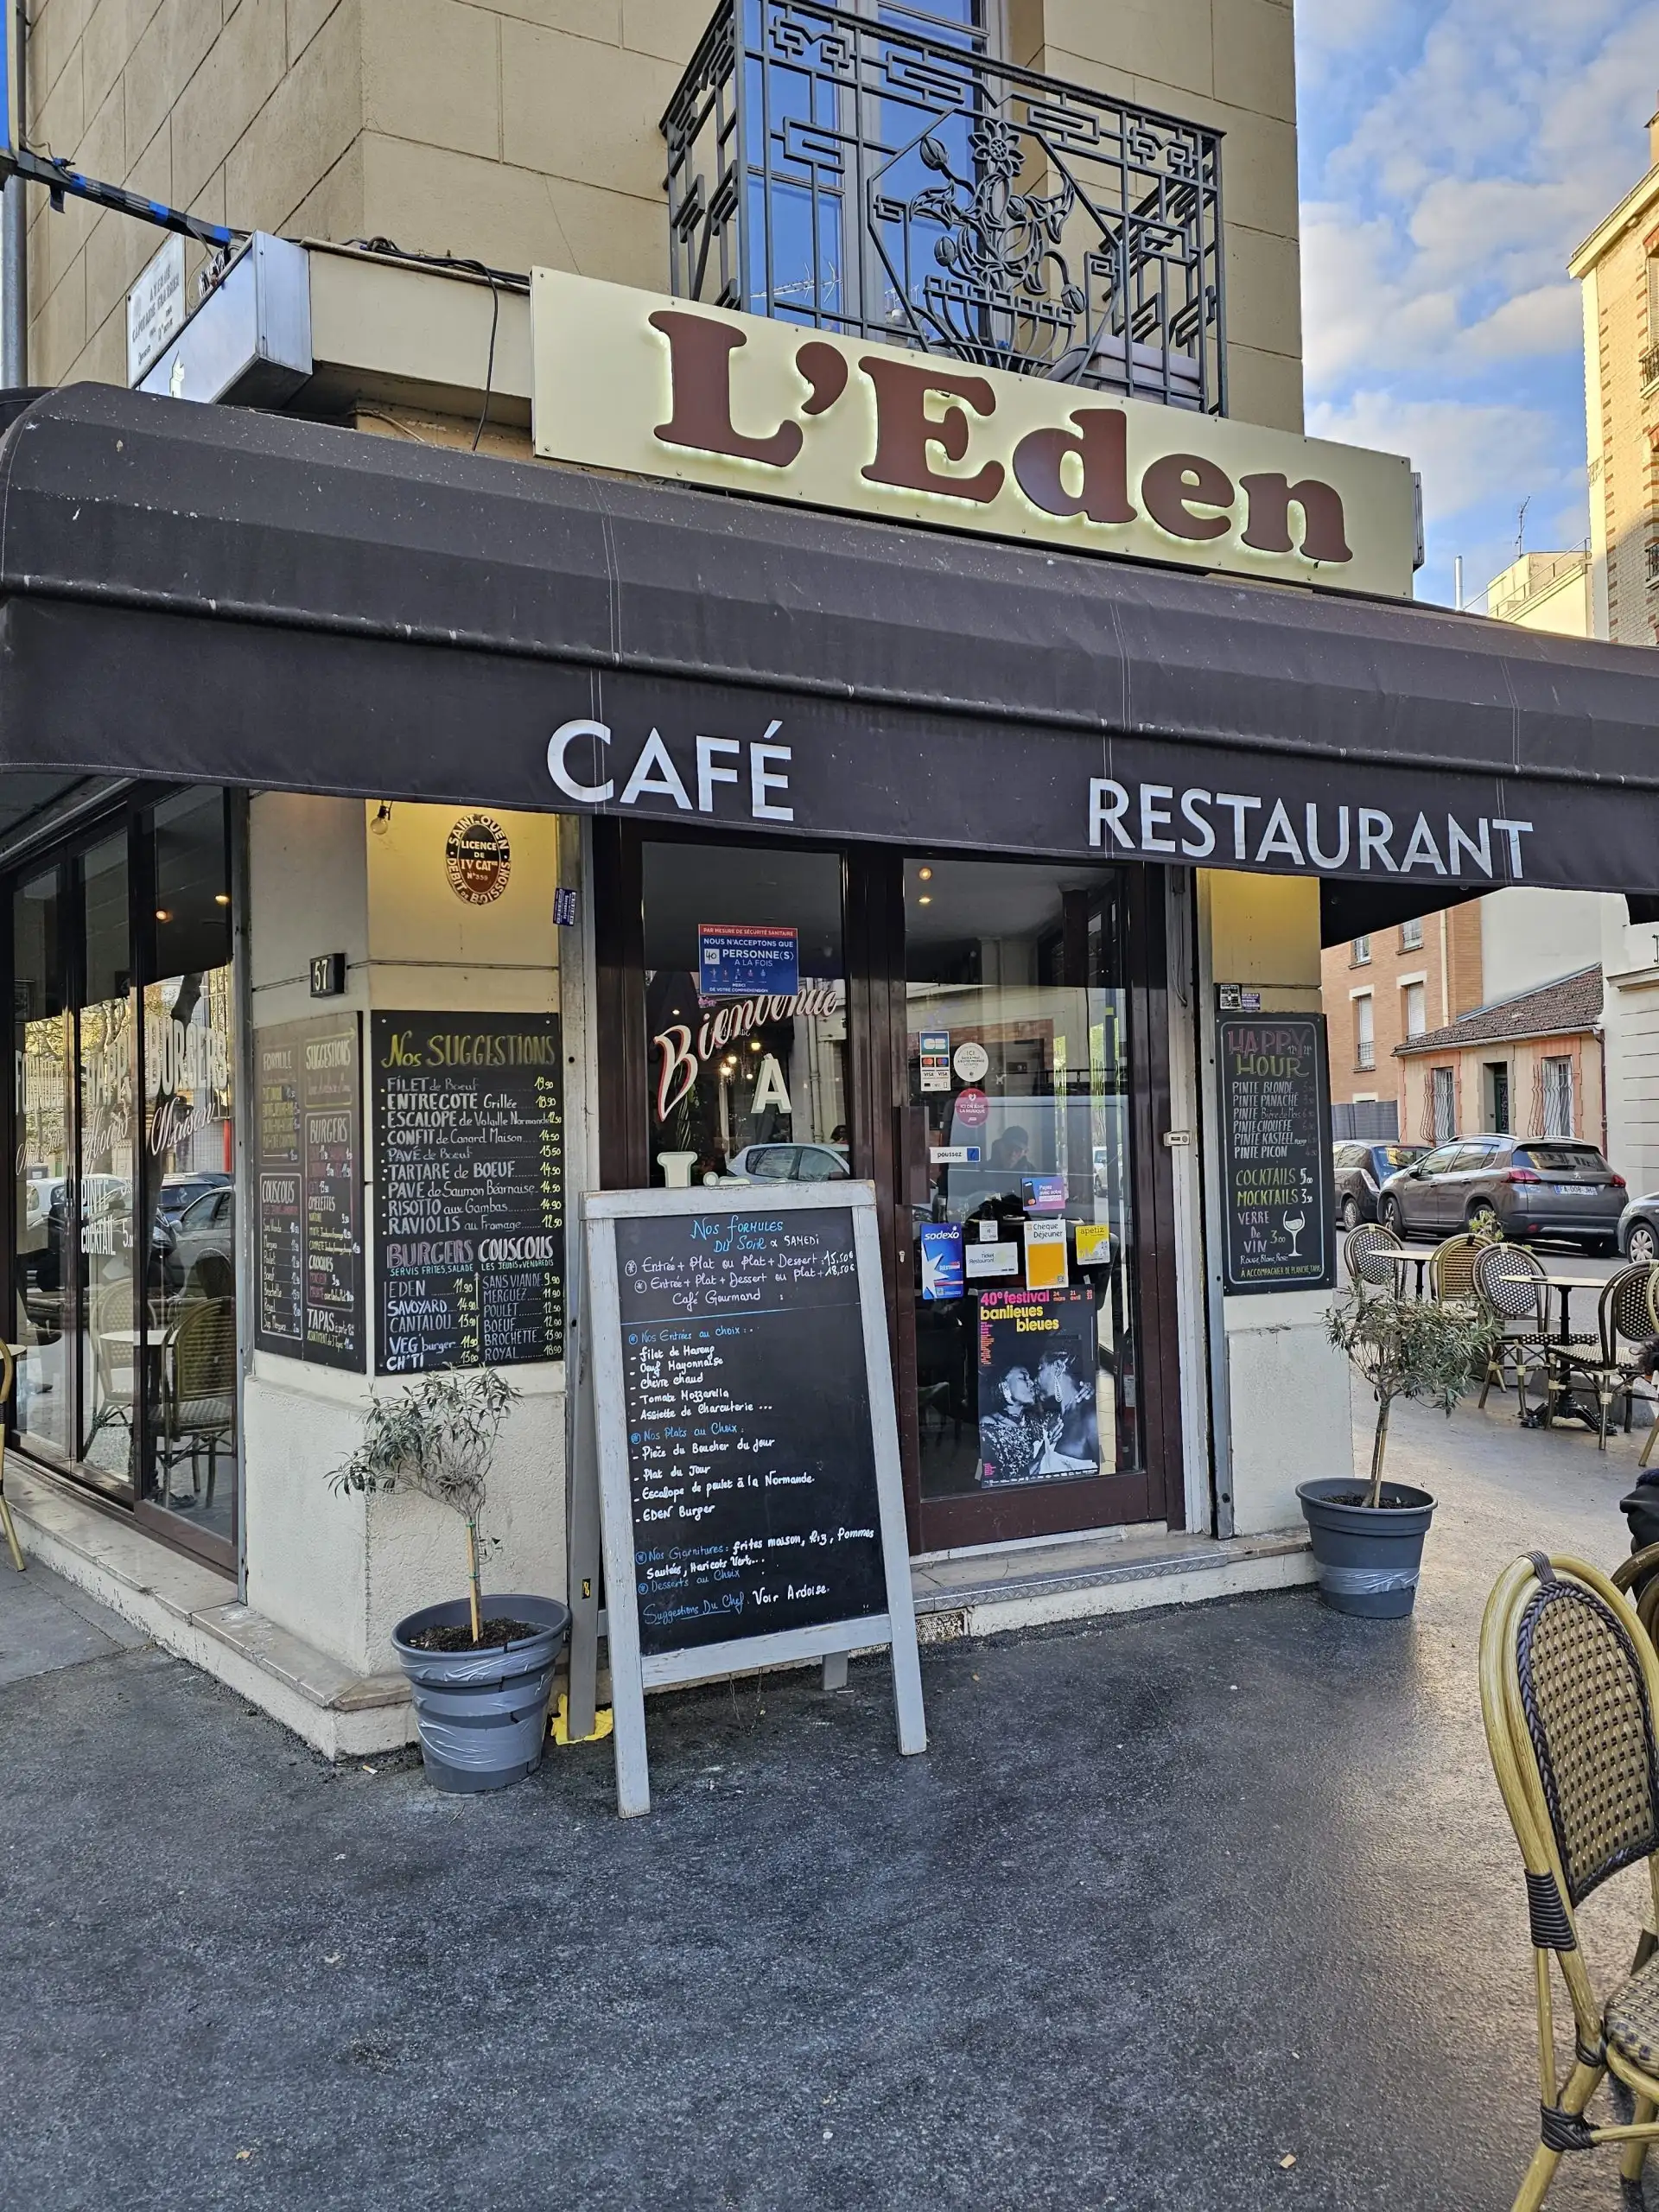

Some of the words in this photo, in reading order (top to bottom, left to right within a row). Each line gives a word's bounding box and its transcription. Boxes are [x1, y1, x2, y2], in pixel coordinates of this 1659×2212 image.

[647, 309, 1355, 564] L'Eden
[545, 719, 795, 823] CAFÉ
[1089, 777, 1535, 880] RESTAURANT
[461, 841, 498, 851] LICENCE
[460, 859, 474, 869] IV
[470, 861, 512, 904] BOISSONS
[705, 950, 717, 960] 40
[722, 949, 794, 962] PERSONNE(S)
[314, 958, 328, 992] 57
[381, 1030, 422, 1069] Nos
[425, 1033, 556, 1066] SUGGESTIONS
[1227, 1027, 1311, 1058] HAPPY
[653, 986, 838, 1122] Bienvenue
[1236, 1053, 1310, 1078] HOUR
[1232, 1082, 1260, 1094] PINTE
[1263, 1082, 1294, 1094] BLONDE
[387, 1093, 478, 1110] ENTRECOTE
[483, 1094, 518, 1109] Grillée
[1233, 1095, 1258, 1106] PINTE
[1262, 1092, 1299, 1107] PANACHÉ
[387, 1111, 457, 1128] ESCALOPE
[474, 1111, 508, 1126] Volaille
[1233, 1108, 1258, 1120] PINTE
[310, 1117, 349, 1144] BURGERS
[1233, 1121, 1256, 1134] PINTE
[1257, 1119, 1293, 1133] CHOUFFE
[387, 1129, 435, 1146] CONFIT
[450, 1128, 486, 1143] Canard
[489, 1128, 522, 1142] Maison
[1234, 1133, 1261, 1146] PINTE
[1262, 1132, 1294, 1145] KASTEEL
[1235, 1147, 1258, 1160] PINTE
[1262, 1146, 1287, 1159] PICON
[388, 1164, 449, 1180] TARTARE
[454, 1166, 469, 1179] de
[474, 1161, 515, 1179] BOEUF
[1236, 1167, 1296, 1185] COCKTAILS
[1300, 1168, 1313, 1185] 5.00
[262, 1180, 295, 1205] COUSCOUS
[442, 1180, 485, 1197] Saumon
[486, 1178, 535, 1194] Béarnaise
[308, 1196, 335, 1211] OMELETTES
[1237, 1188, 1299, 1208] MOCKTAILS
[1301, 1189, 1313, 1204] 3.50
[388, 1198, 442, 1217] RISOTTO
[443, 1204, 462, 1215] aux
[465, 1197, 508, 1213] Gambas
[389, 1216, 461, 1236] RAVIOLIS
[481, 1215, 521, 1231] Fromage
[541, 1214, 562, 1228] 12.50
[1237, 1211, 1270, 1225] VERRE
[81, 1214, 117, 1255] COCKTAIL
[690, 1217, 719, 1241] Nos
[925, 1230, 960, 1241] sodexo
[1080, 1226, 1104, 1236] apetiz
[1251, 1226, 1262, 1239] De
[1270, 1230, 1286, 1244] 3.00
[387, 1239, 474, 1268] BURGERS
[478, 1235, 554, 1262] COUSCOUS
[1243, 1240, 1268, 1254] VIN
[642, 1256, 676, 1273] Entrée
[778, 1253, 818, 1268] Dessert
[1247, 1266, 1284, 1277] ACCOMPAGNER
[390, 1267, 419, 1277] SERVIS
[482, 1274, 508, 1289] SANS
[511, 1272, 543, 1287] VIANDE
[389, 1280, 426, 1298] EDEN
[483, 1287, 527, 1305] MERGUEZ
[1004, 1290, 1050, 1305] festival
[387, 1300, 448, 1317] SAVOYARD
[672, 1290, 698, 1312] Café
[705, 1288, 760, 1305] Gourmand
[484, 1302, 518, 1318] POULET
[981, 1305, 1044, 1320] banlieues
[307, 1308, 334, 1332] TAPAS
[390, 1315, 452, 1333] CANTALOU
[484, 1318, 516, 1333] BOEUF
[1016, 1319, 1059, 1332] bleues
[484, 1331, 537, 1346] BROCHETTE
[641, 1332, 657, 1344] Nos
[659, 1329, 692, 1343] Entrées
[485, 1346, 518, 1362] ROYAL
[683, 1344, 715, 1359] Hareng
[668, 1357, 723, 1376] Mayonnaise
[673, 1372, 704, 1386] chaud
[639, 1393, 677, 1405] Tomate
[681, 1388, 729, 1403] Mozzarella
[640, 1408, 677, 1421] Assiette
[698, 1401, 753, 1414] Charcuterie
[644, 1430, 661, 1441] Nos
[664, 1427, 687, 1439] Plats
[692, 1441, 729, 1455] Boucher
[643, 1468, 663, 1482] Plat
[689, 1465, 711, 1477] Jour
[642, 1486, 684, 1503] Escalope
[706, 1478, 733, 1497] poulet
[643, 1506, 674, 1522] EDEN
[678, 1503, 715, 1521] Burger
[837, 1527, 874, 1542] Pommes
[690, 1559, 728, 1573] Haricots
[652, 1578, 690, 1592] Desserts
[753, 1586, 779, 1605] Voir
